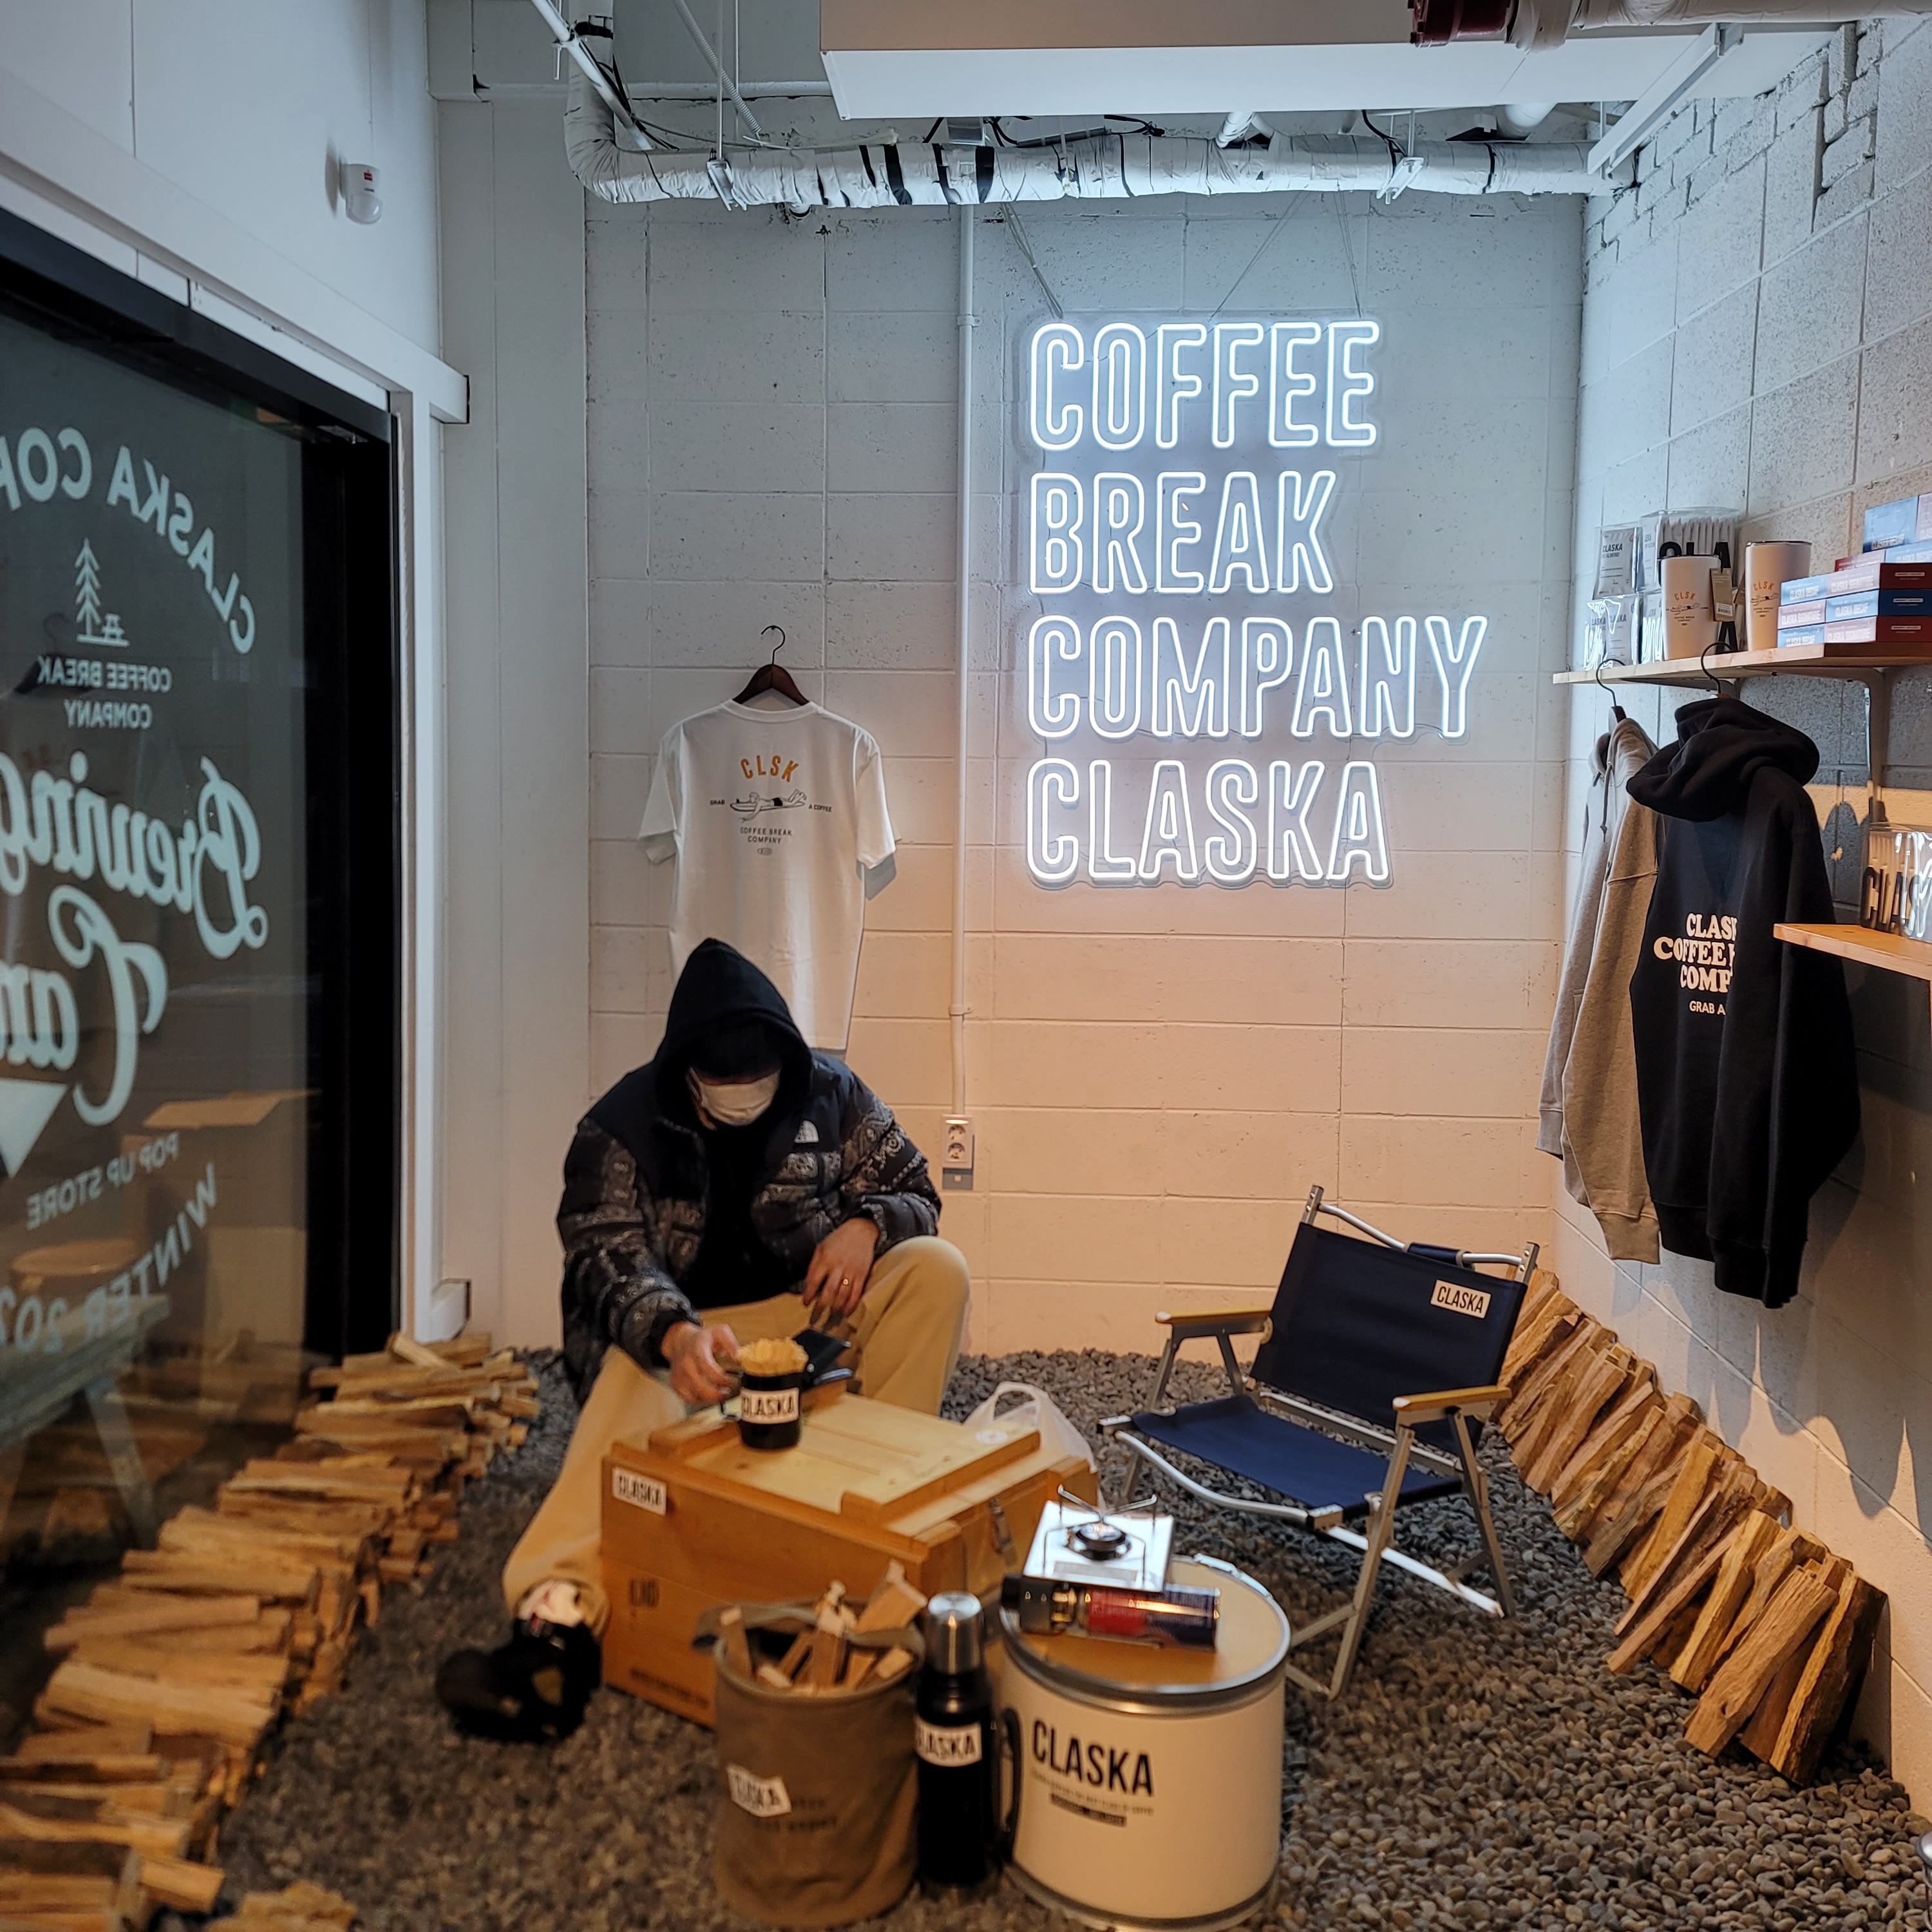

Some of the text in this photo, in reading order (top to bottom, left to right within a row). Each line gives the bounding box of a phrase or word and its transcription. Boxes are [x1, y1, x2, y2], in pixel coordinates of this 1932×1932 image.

[1030, 320, 1379, 450] COFFEE
[1030, 471, 1336, 594] BREAK
[1674, 591, 1696, 601] CLSK
[1753, 581, 1775, 591] CLSK
[1028, 615, 1488, 738] COMPANY
[741, 755, 799, 782] CLSK
[741, 827, 792, 837] COFFEE BREAK
[1027, 758, 1389, 882] CLASKA
[748, 836, 781, 844] COMPANY
[1653, 936, 1727, 967] COFFEE
[1680, 965, 1731, 993] COMP
[1689, 1000, 1726, 1016] GRAB A
[1437, 1285, 1484, 1314] CLASKA
[1032, 1719, 1154, 1797] CLASKA
